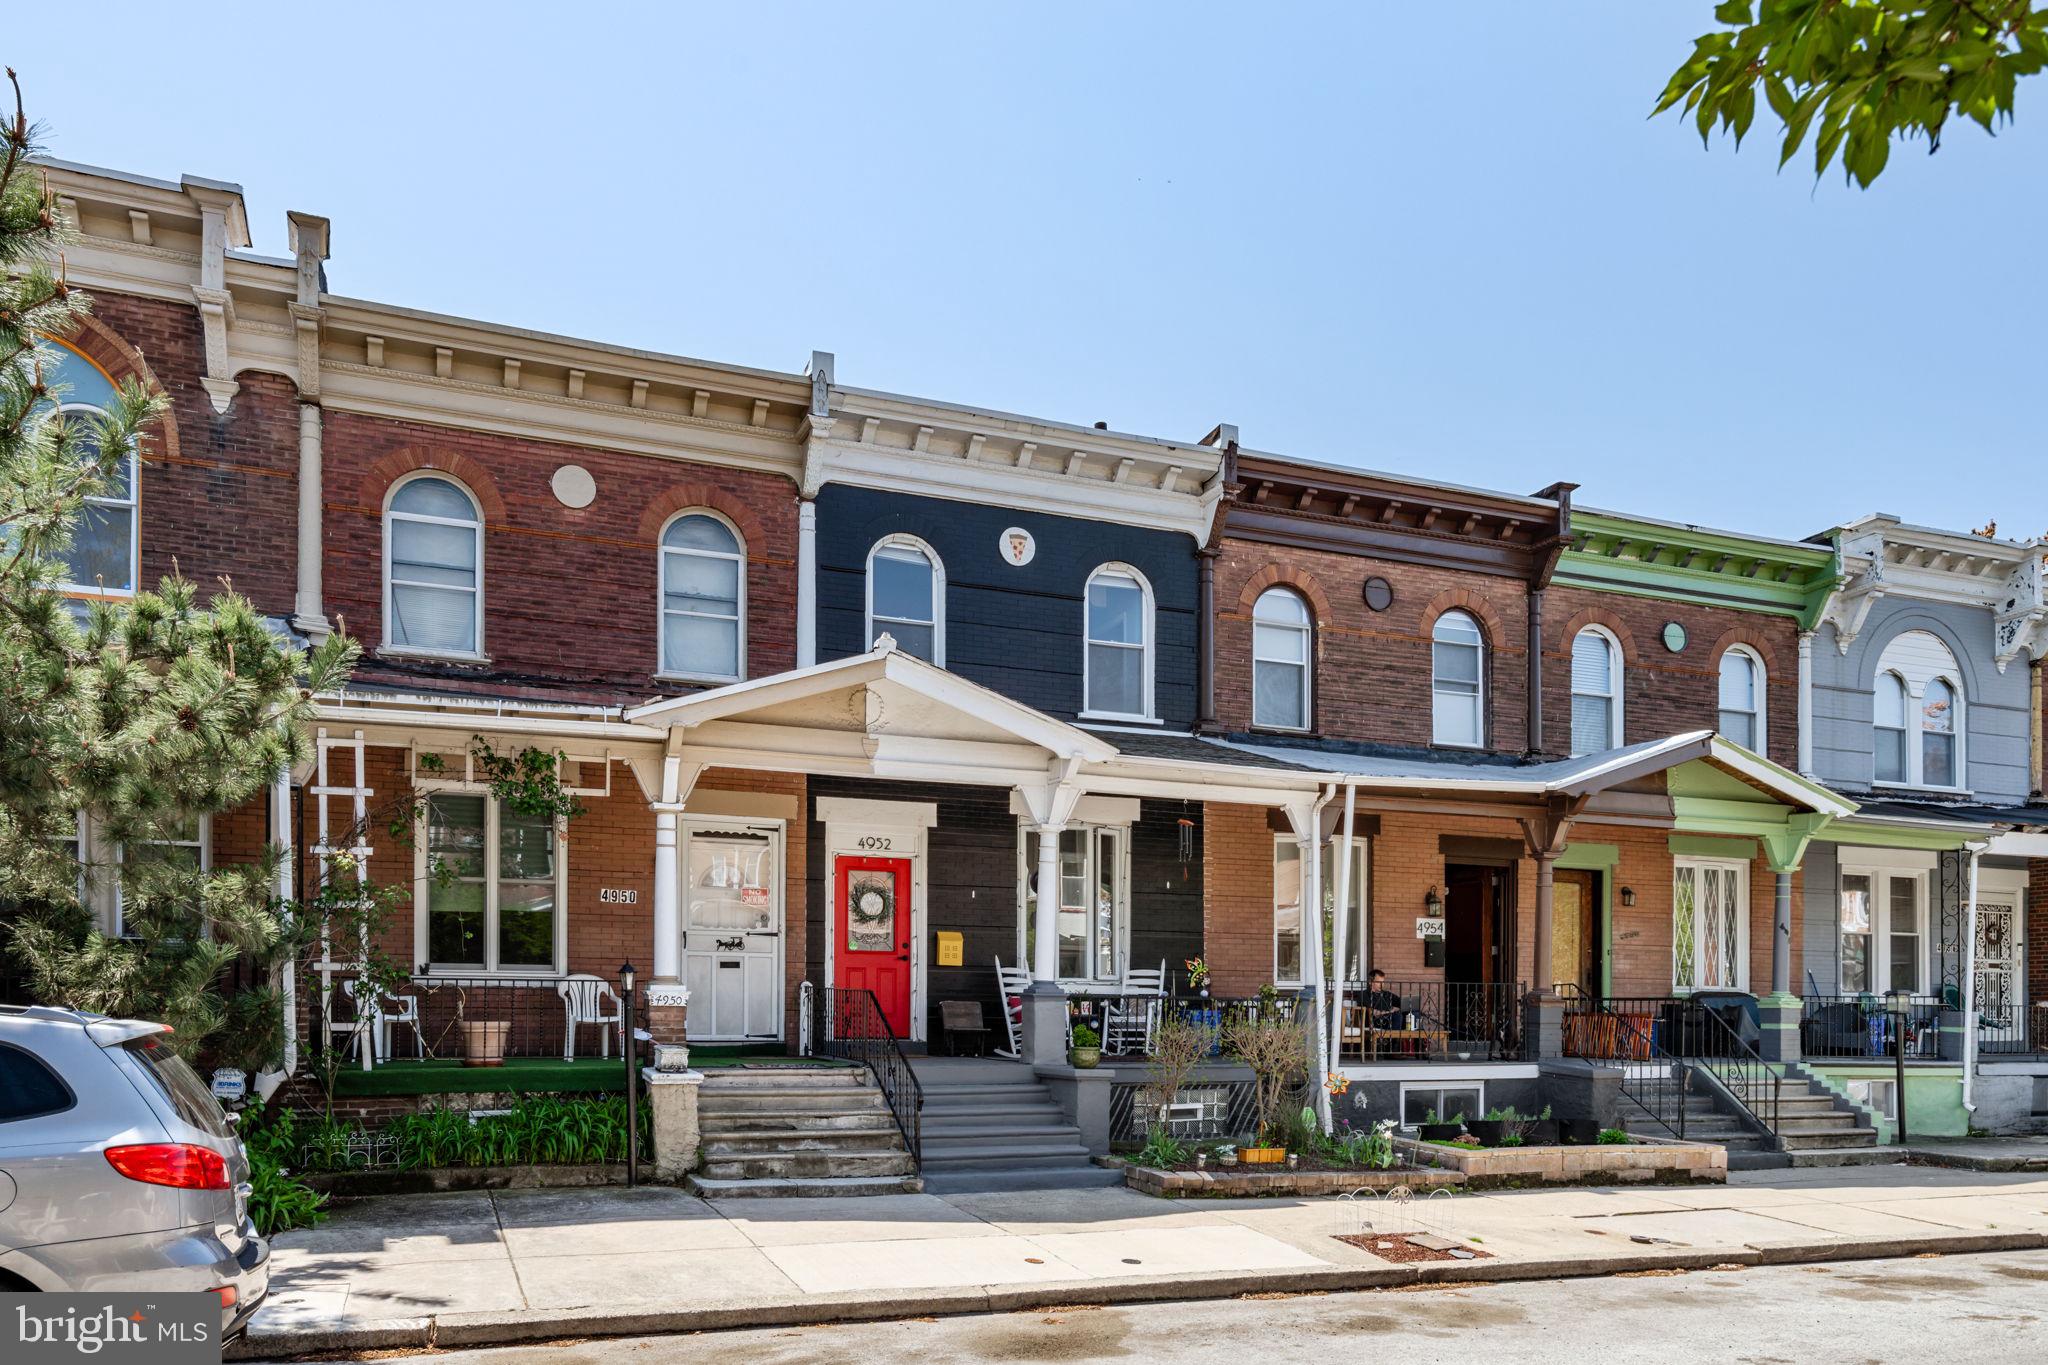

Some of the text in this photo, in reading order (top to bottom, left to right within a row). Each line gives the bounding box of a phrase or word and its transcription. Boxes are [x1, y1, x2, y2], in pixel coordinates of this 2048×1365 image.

[858, 836, 892, 850] 4952
[601, 889, 636, 903] 4950
[742, 895, 768, 905] SMOKING
[1417, 922, 1443, 934] 4954
[655, 995, 682, 1005] 4950
